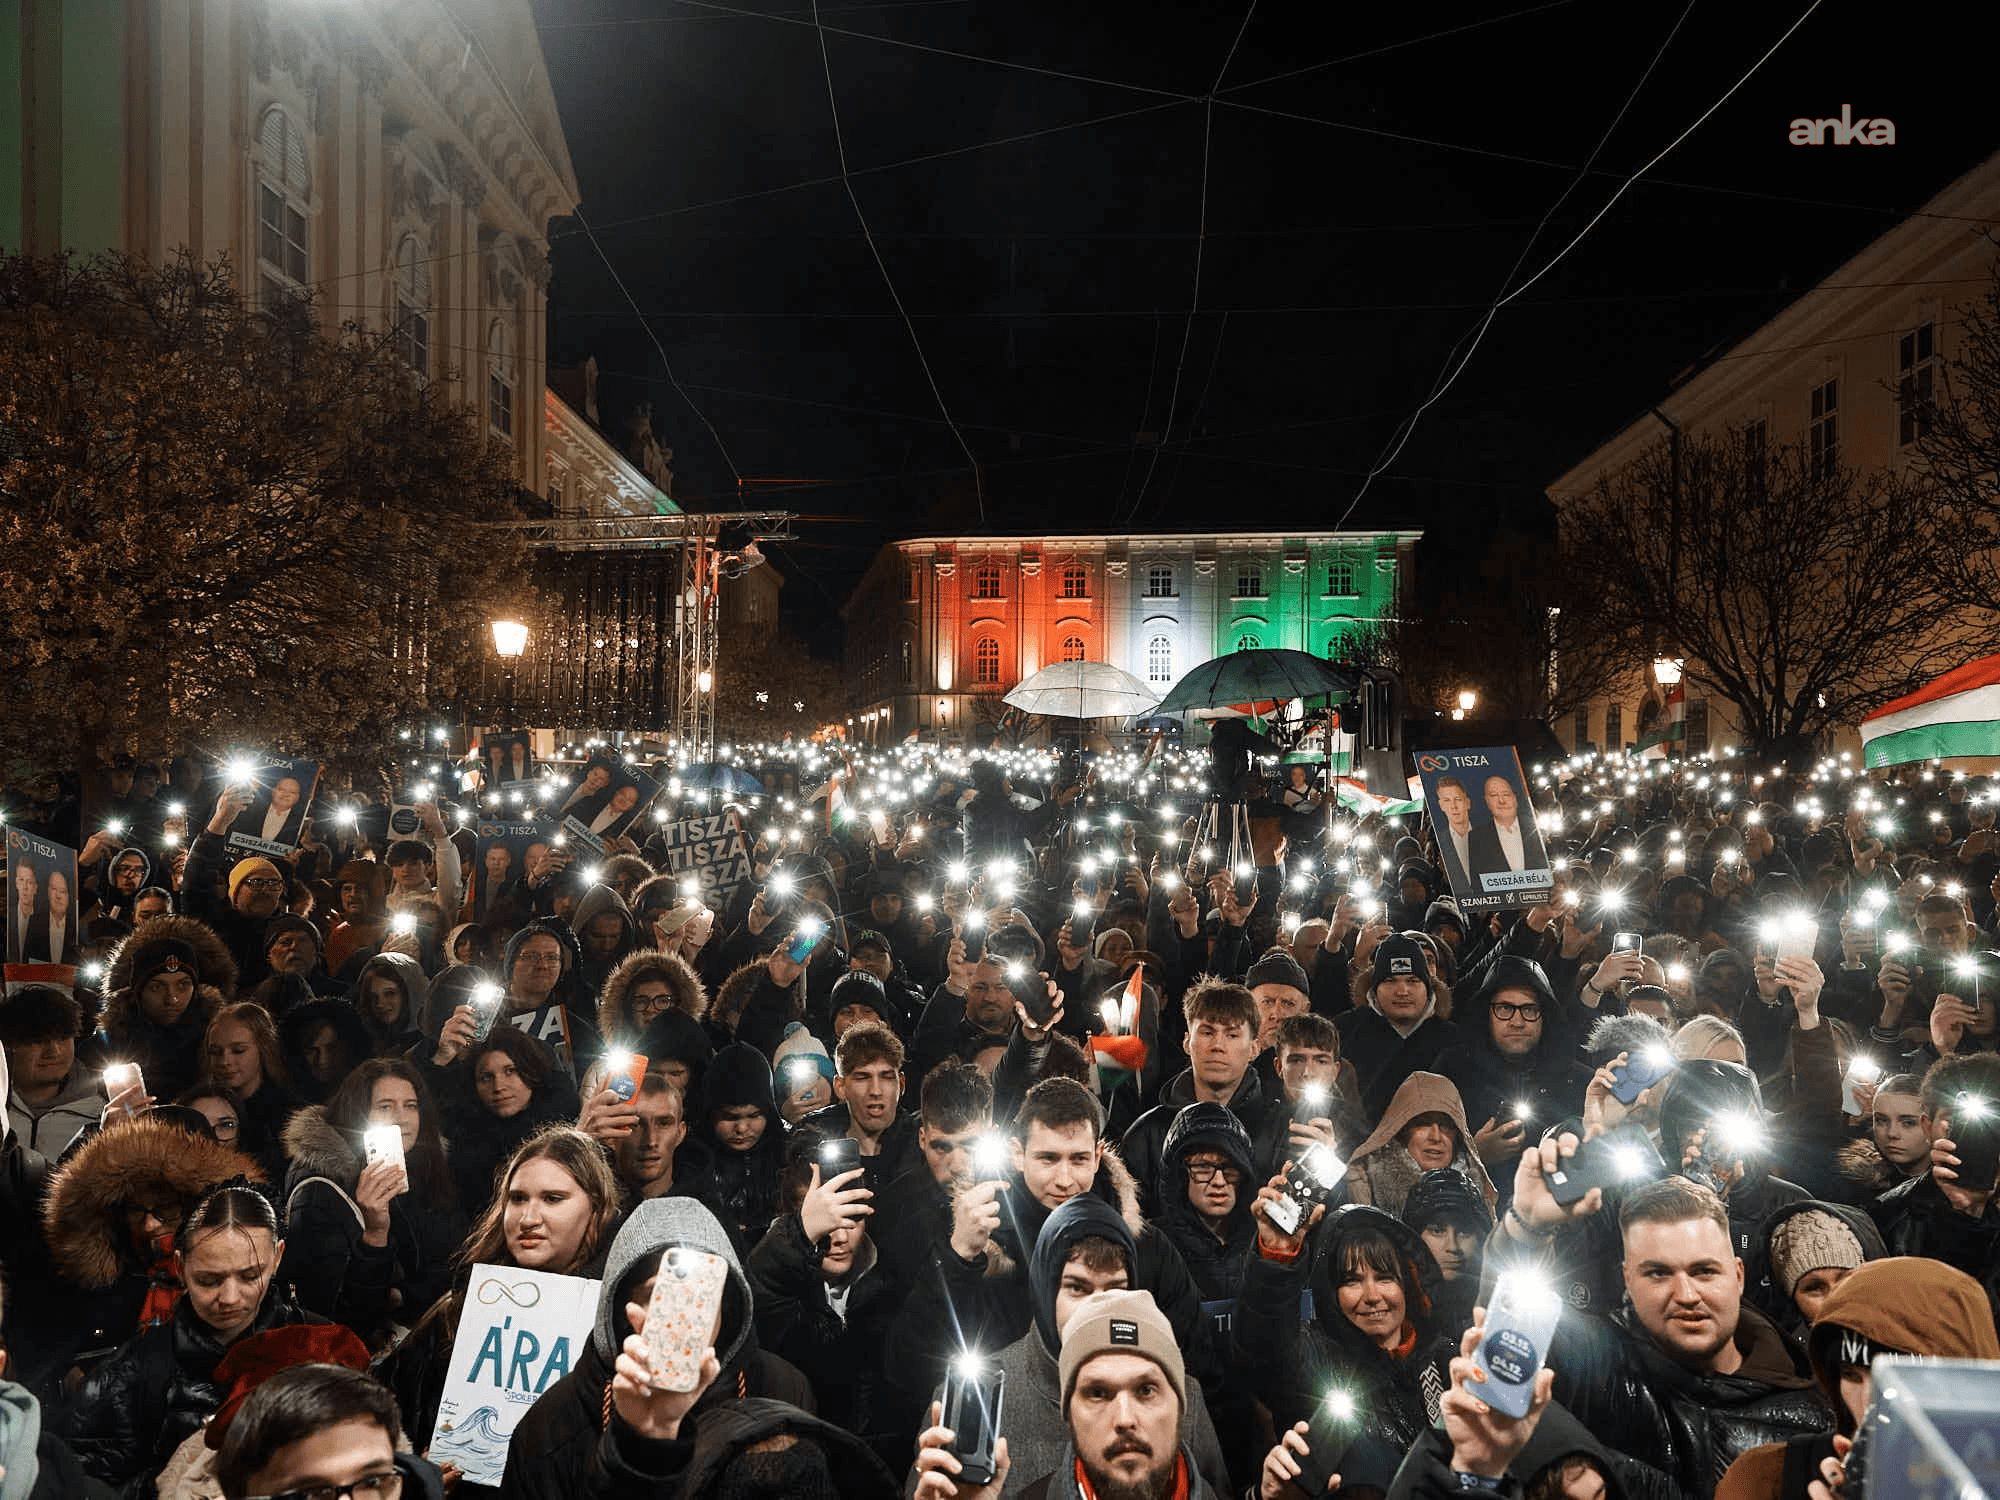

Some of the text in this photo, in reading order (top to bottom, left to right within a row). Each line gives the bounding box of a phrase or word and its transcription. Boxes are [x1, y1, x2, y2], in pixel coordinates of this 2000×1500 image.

[264, 755, 293, 771] TISZA
[1452, 755, 1489, 768] TISZA
[509, 826, 537, 836] TISZA
[662, 812, 738, 846] TISZA
[32, 841, 57, 860] TISZA
[669, 837, 746, 870] TISZA
[1487, 872, 1548, 887] CSISZÁR BÉLA
